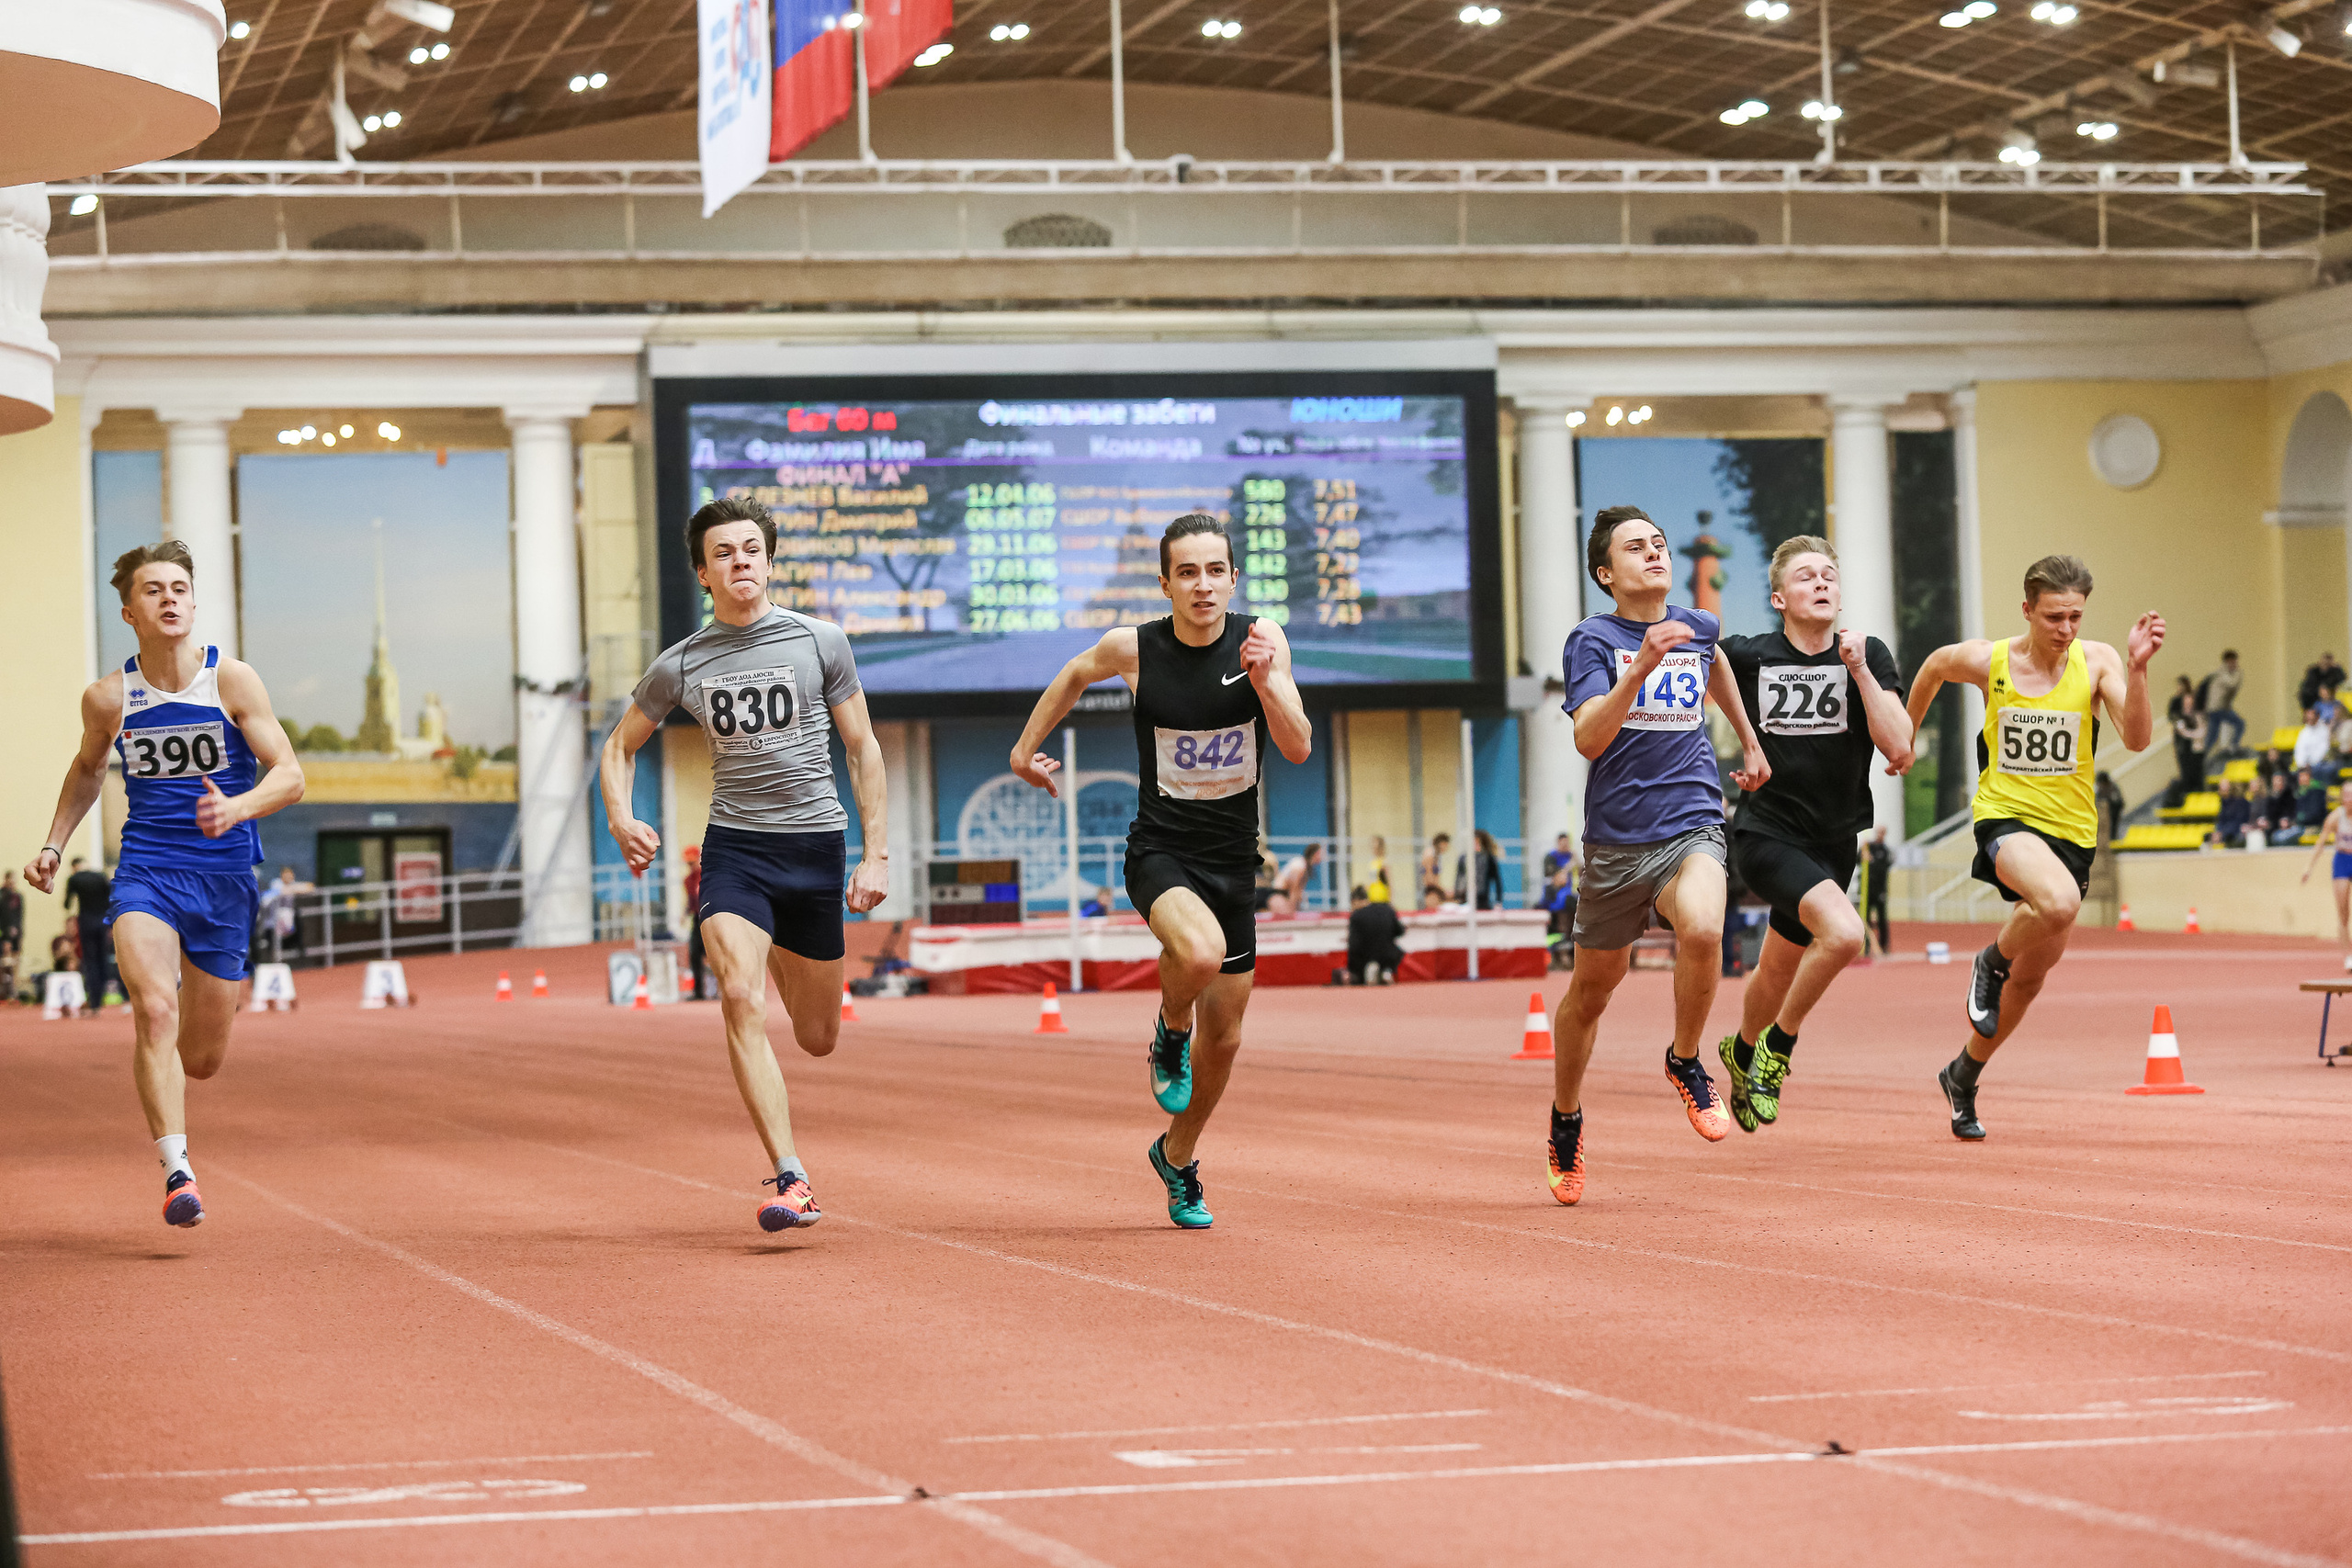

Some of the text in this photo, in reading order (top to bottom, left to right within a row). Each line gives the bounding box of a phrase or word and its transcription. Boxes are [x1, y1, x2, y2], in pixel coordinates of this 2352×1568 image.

[836, 407, 869, 432] 60
[978, 398, 1216, 426] Финальные забеги
[1290, 397, 1403, 423] ЮНОШИ
[745, 436, 925, 461] Фамилия Имя
[1090, 434, 1202, 460] Команда
[1245, 502, 1286, 525] 226
[1246, 528, 1286, 550] 143
[1658, 658, 1697, 667] СШОР-2
[1637, 671, 1699, 708] 143
[1779, 673, 1827, 682] СДЮСШОР
[710, 683, 793, 737] 830
[1767, 682, 1840, 718] 226
[1626, 712, 1675, 722] ОСКОВСКОГО
[2012, 714, 2064, 726] СШОР № 1
[133, 733, 220, 776] 390
[1174, 730, 1244, 770] 842
[2004, 725, 2072, 762] 580
[267, 972, 282, 994] 4
